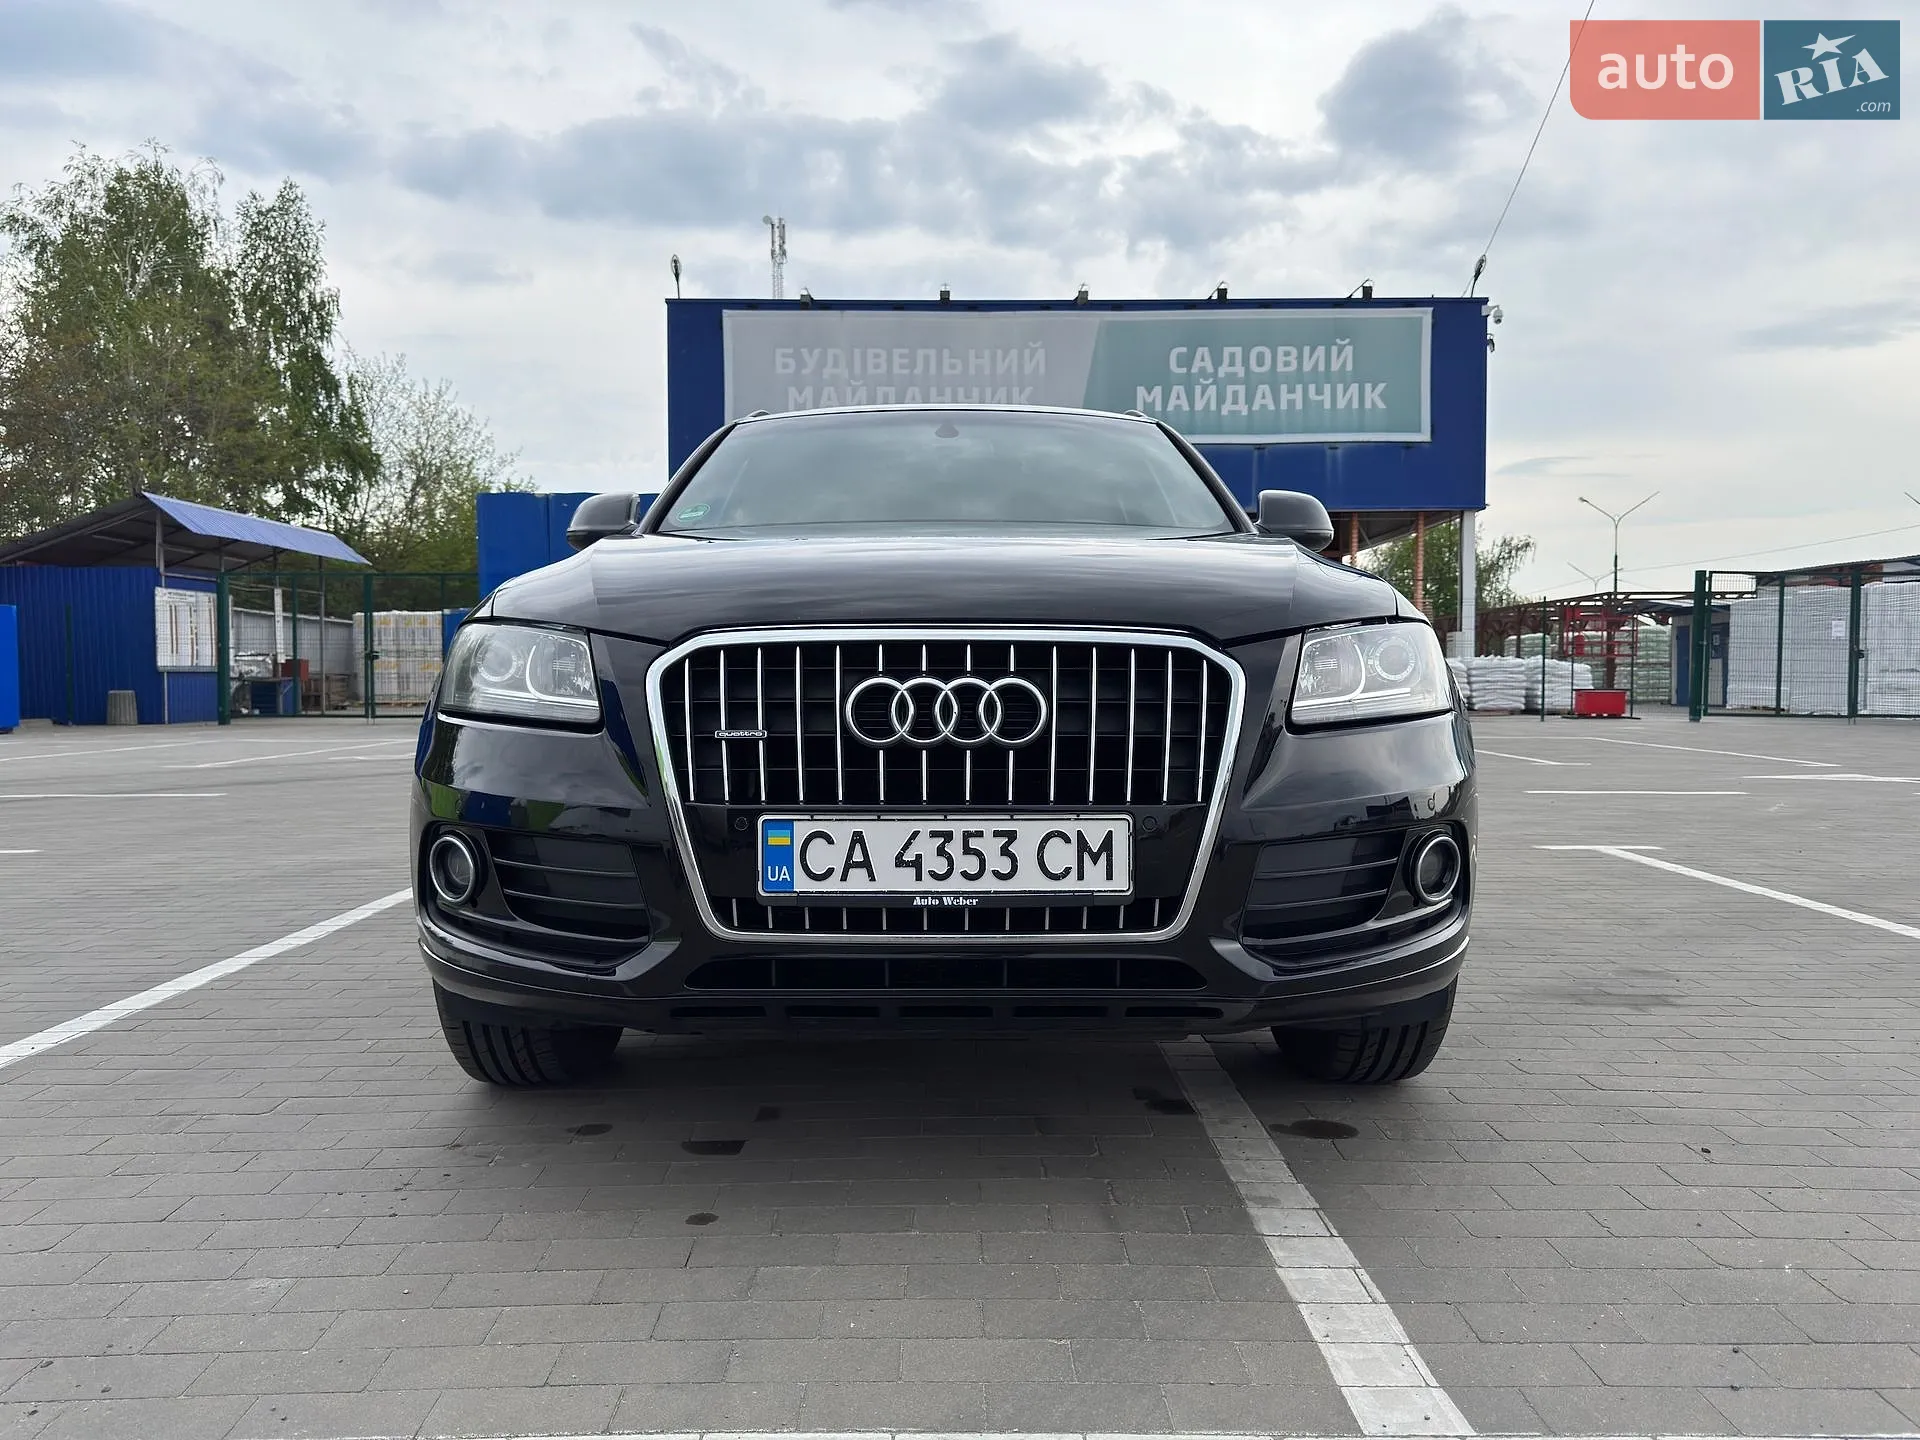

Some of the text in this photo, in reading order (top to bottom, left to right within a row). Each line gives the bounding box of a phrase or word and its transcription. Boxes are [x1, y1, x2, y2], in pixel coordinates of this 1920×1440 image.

[775, 341, 1046, 378] БУДІВЕЛЬНИЙ
[1169, 338, 1354, 377] САДОВИЙ
[1136, 377, 1388, 416] МАЙДАНЧИК
[767, 866, 791, 882] UA
[799, 829, 1114, 882] CA 4353 CM
[912, 896, 979, 906] Auto Weber
